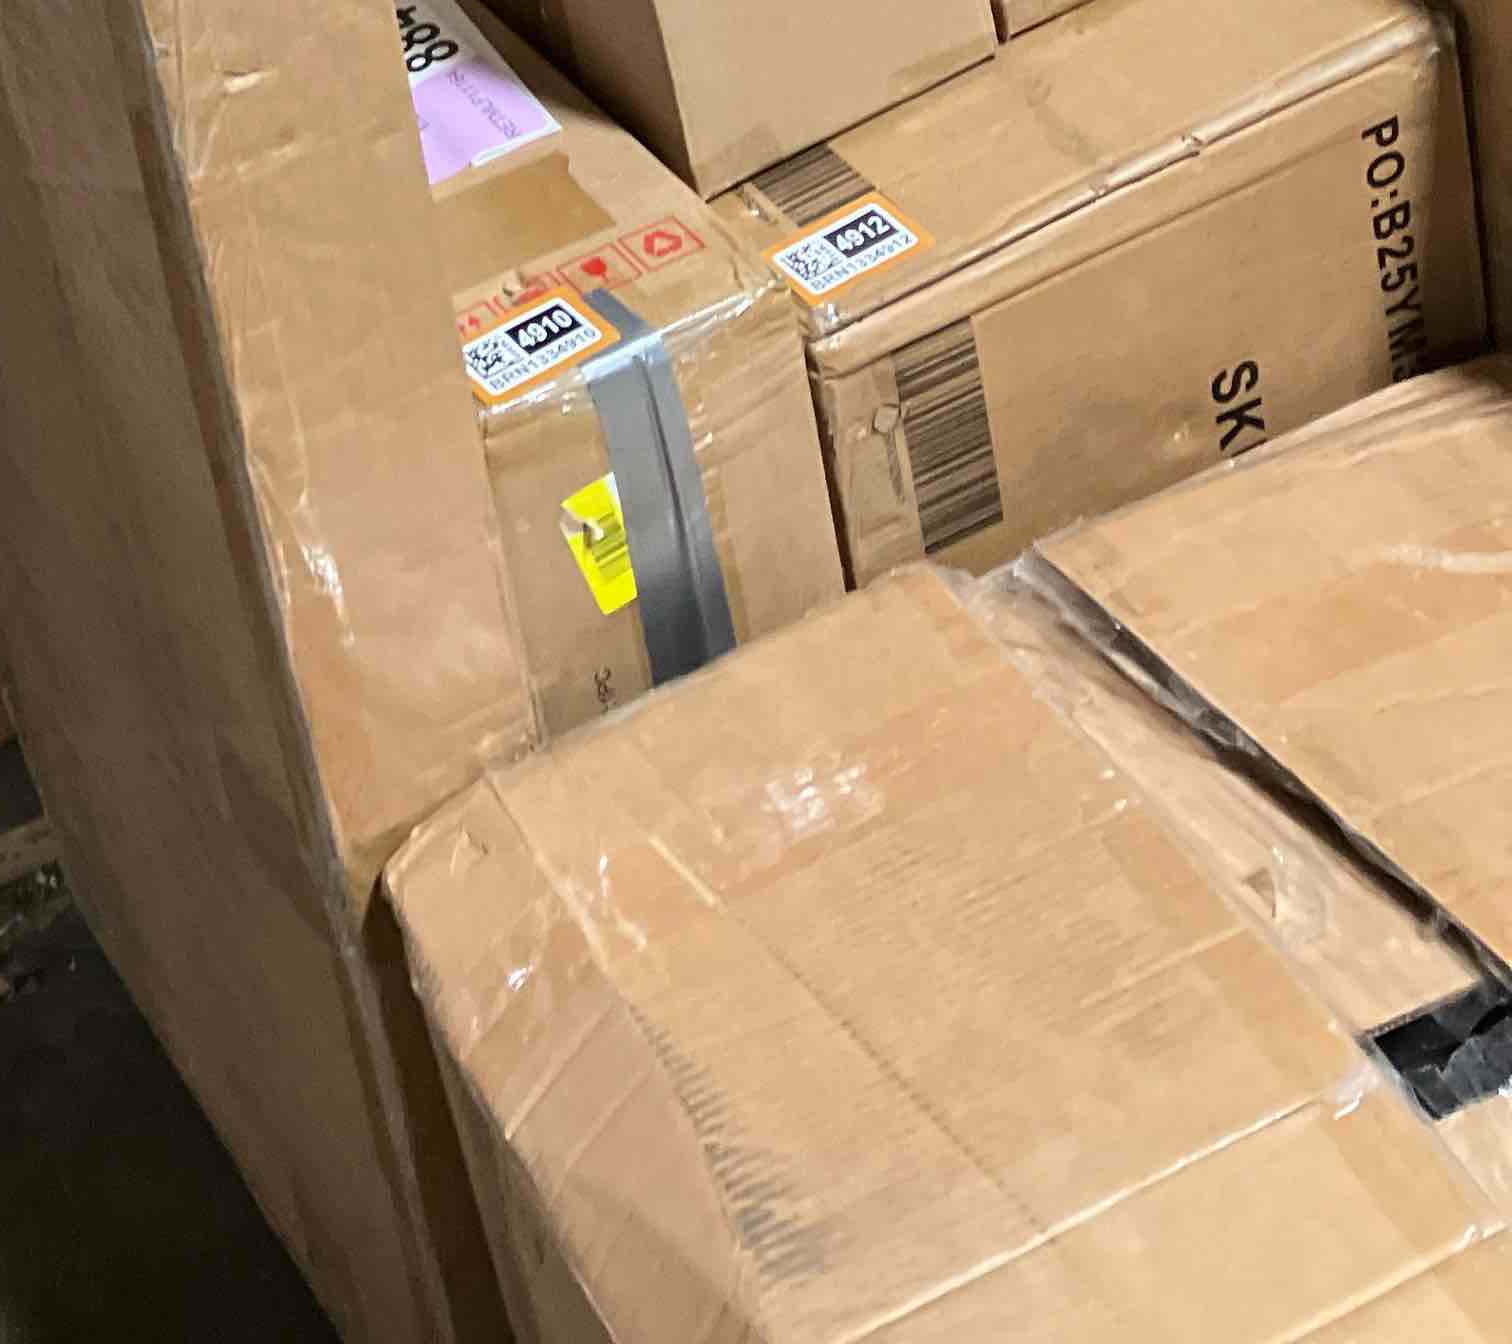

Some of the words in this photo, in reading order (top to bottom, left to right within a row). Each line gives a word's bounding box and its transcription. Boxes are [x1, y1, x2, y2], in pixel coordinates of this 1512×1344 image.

[835, 215, 890, 255] 4912
[515, 308, 573, 351] 4910
[1210, 358, 1268, 451] SK
